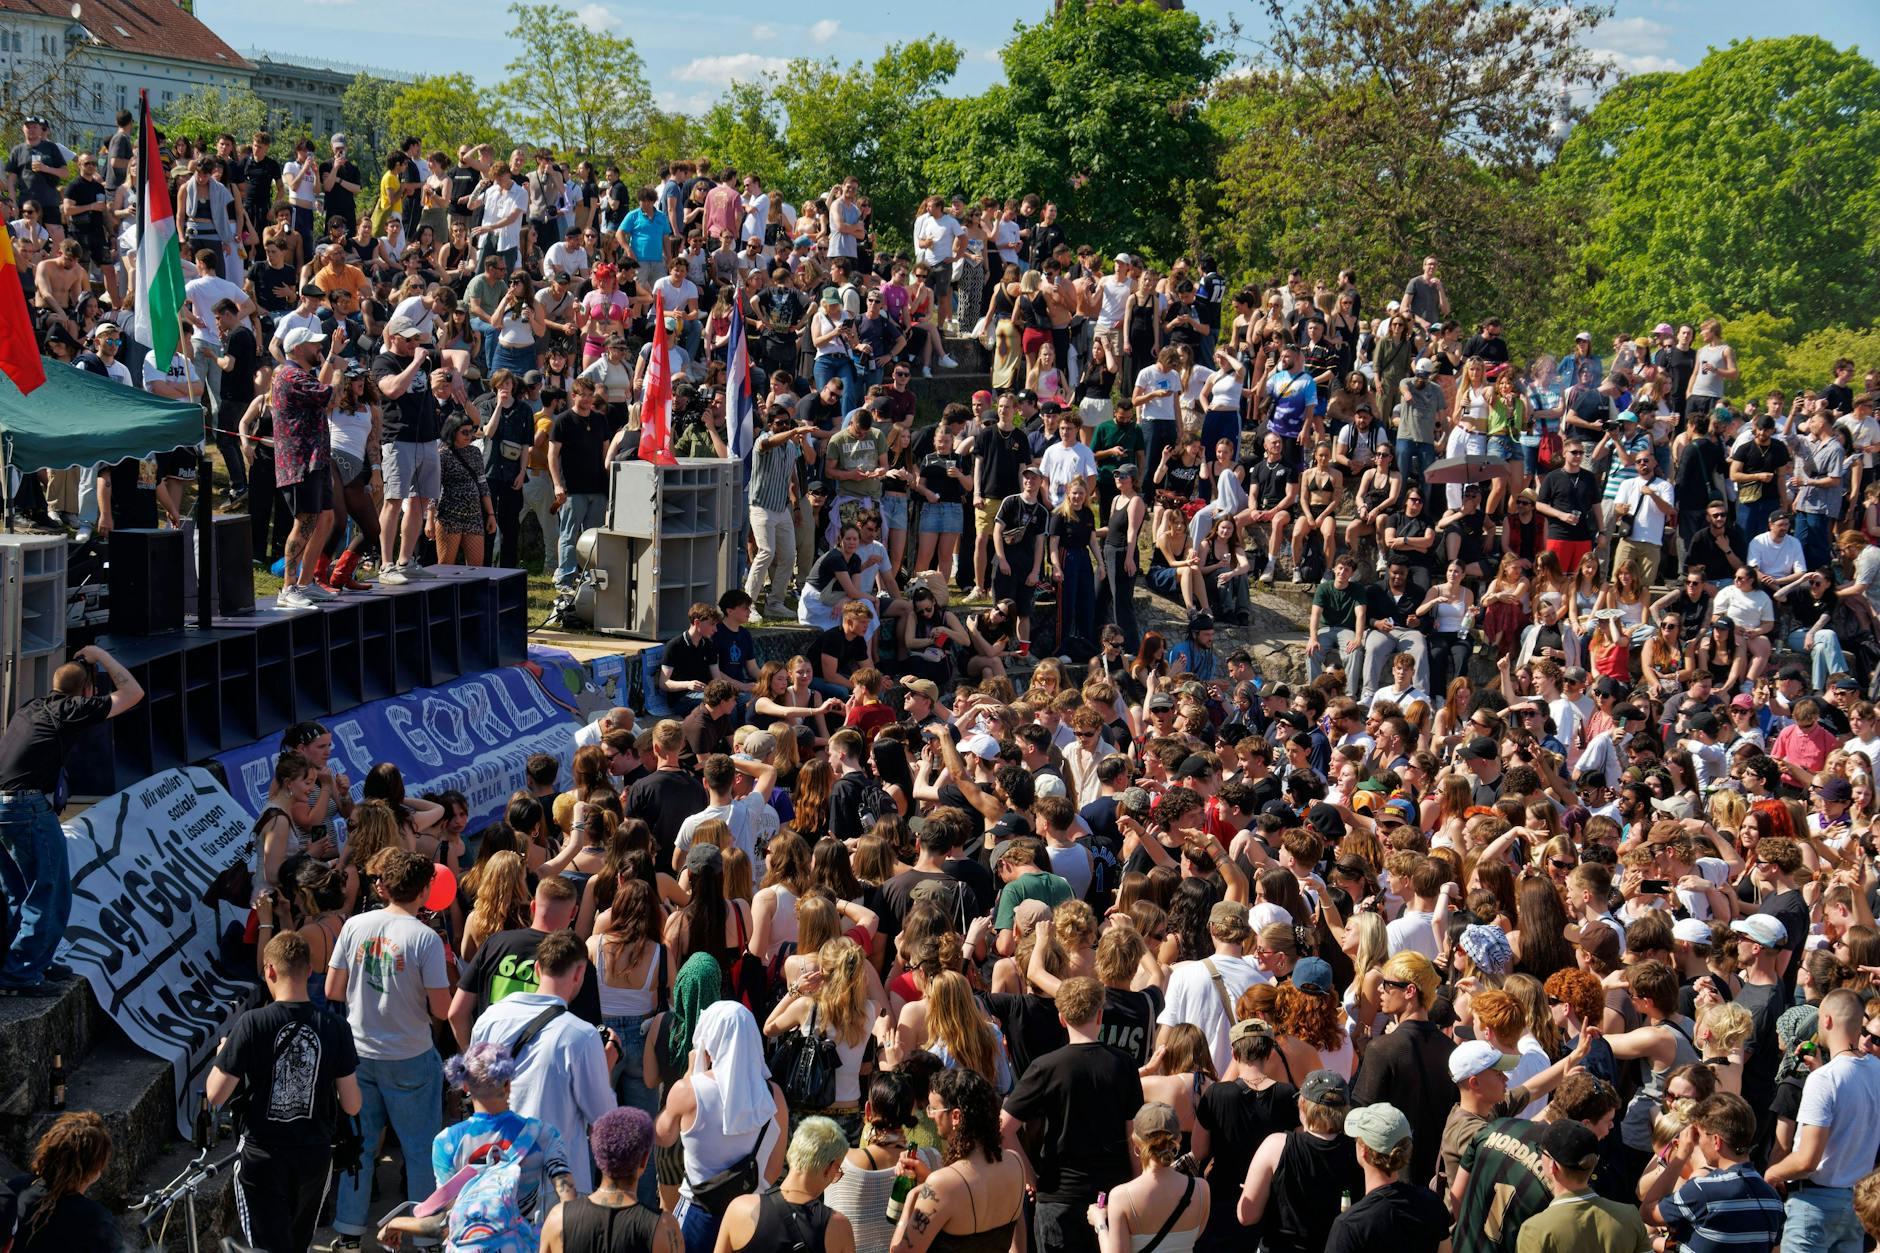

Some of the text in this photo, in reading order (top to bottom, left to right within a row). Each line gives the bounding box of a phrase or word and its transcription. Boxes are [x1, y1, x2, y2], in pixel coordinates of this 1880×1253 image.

[139, 774, 185, 809] Wir wollen
[167, 794, 197, 821] soziale
[200, 819, 247, 858] für soziale
